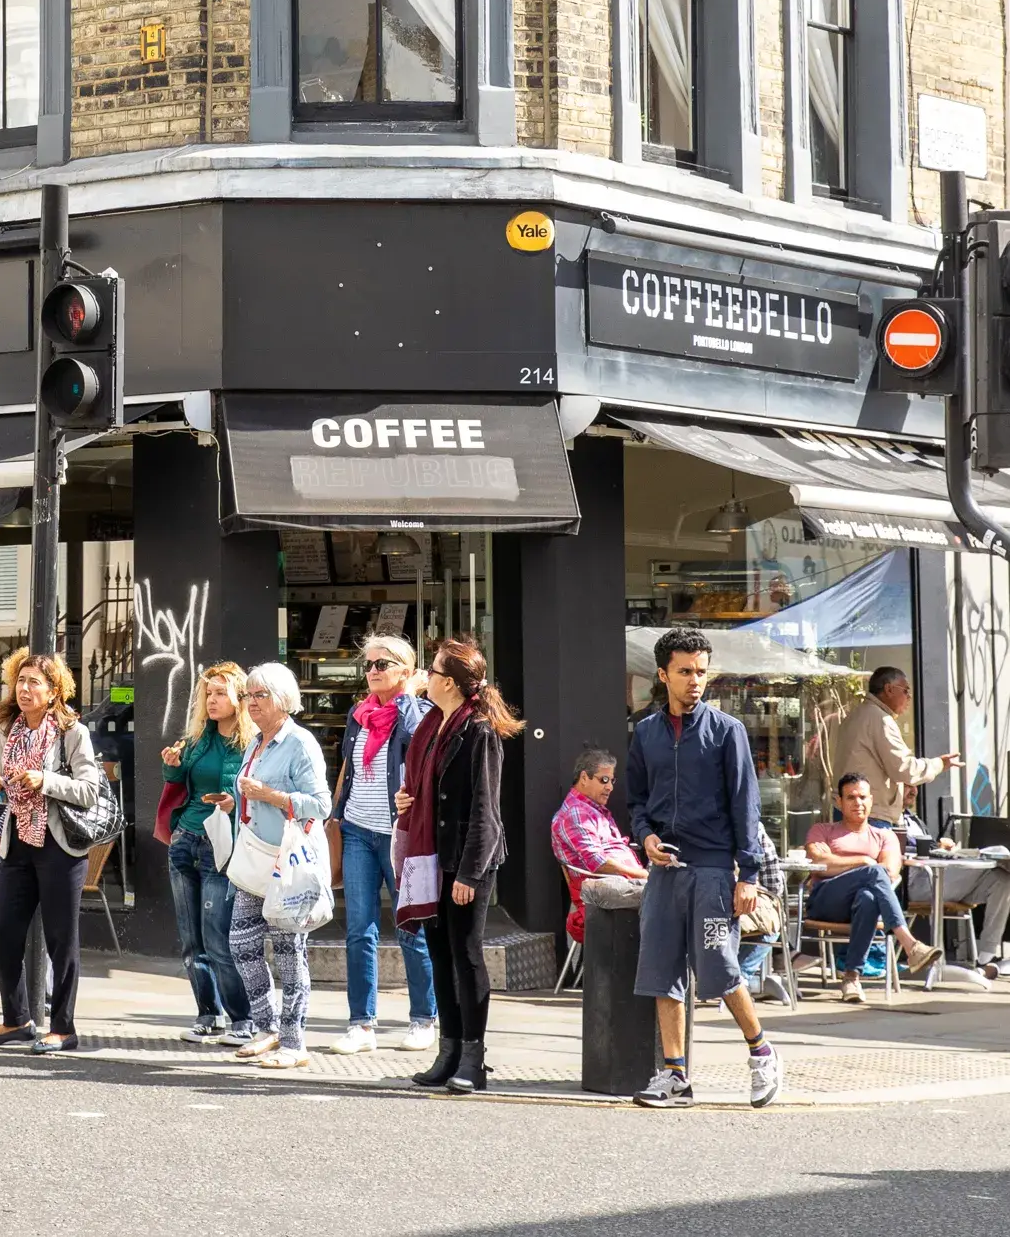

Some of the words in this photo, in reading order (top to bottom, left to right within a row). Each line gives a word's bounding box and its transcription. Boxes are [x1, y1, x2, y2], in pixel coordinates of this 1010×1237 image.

[517, 225, 547, 238] Yale
[622, 269, 833, 345] COFFEEBELLO
[693, 335, 730, 352] PORTOBELLO
[730, 340, 754, 355] LONDON
[520, 368, 555, 385] 214
[311, 418, 486, 449] COFFEE
[390, 520, 425, 529] Welcome
[703, 922, 729, 941] 26
